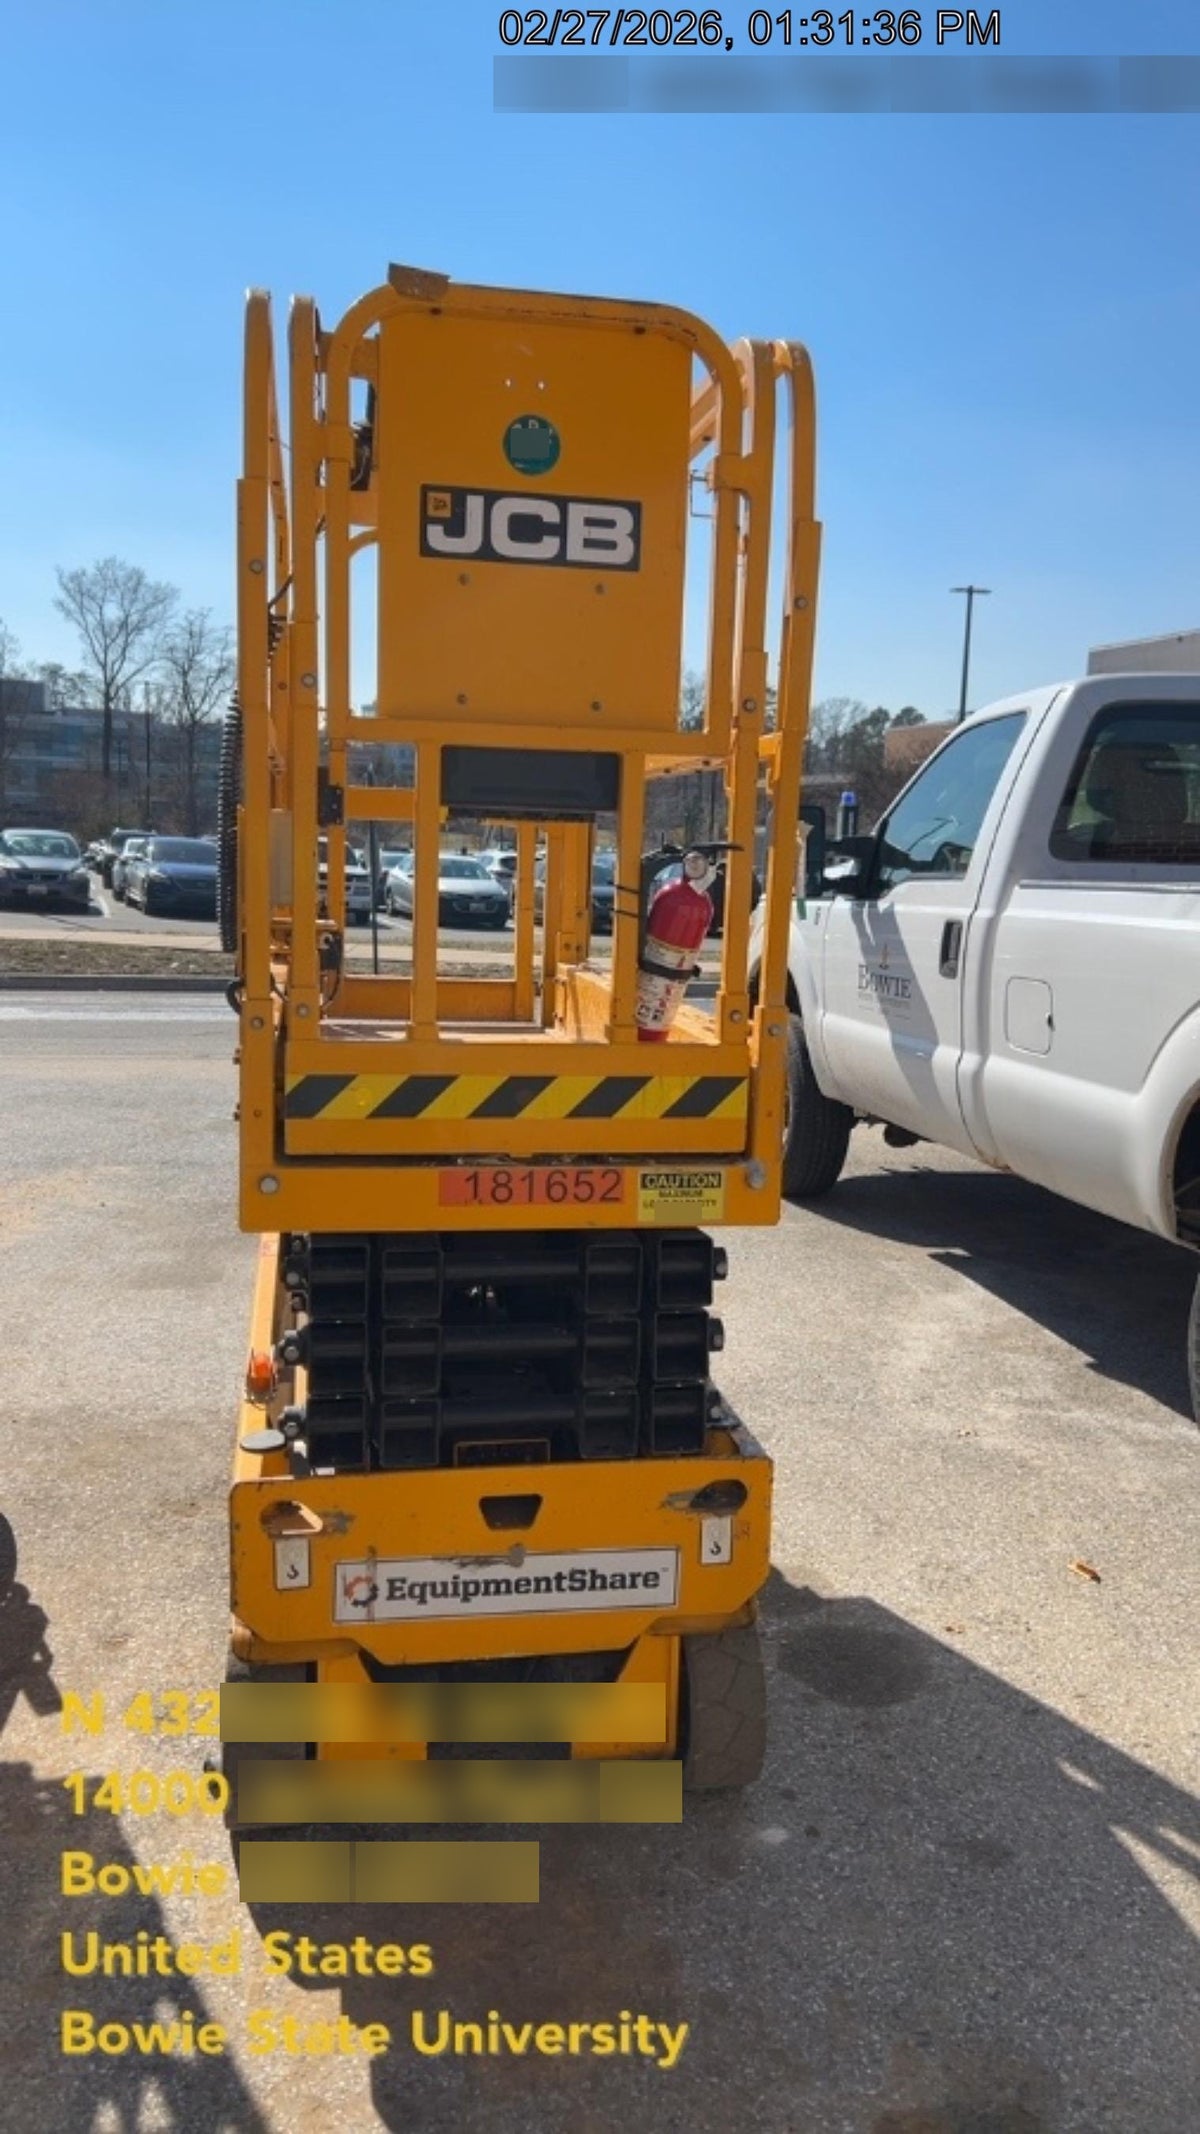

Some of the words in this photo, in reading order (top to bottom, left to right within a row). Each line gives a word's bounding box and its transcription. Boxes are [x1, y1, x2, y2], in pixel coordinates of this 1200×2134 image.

[426, 494, 635, 566] JCB
[464, 1170, 622, 1204] 181652
[644, 1173, 720, 1188] CAUTION
[386, 1567, 660, 1606] EquipmentShare
